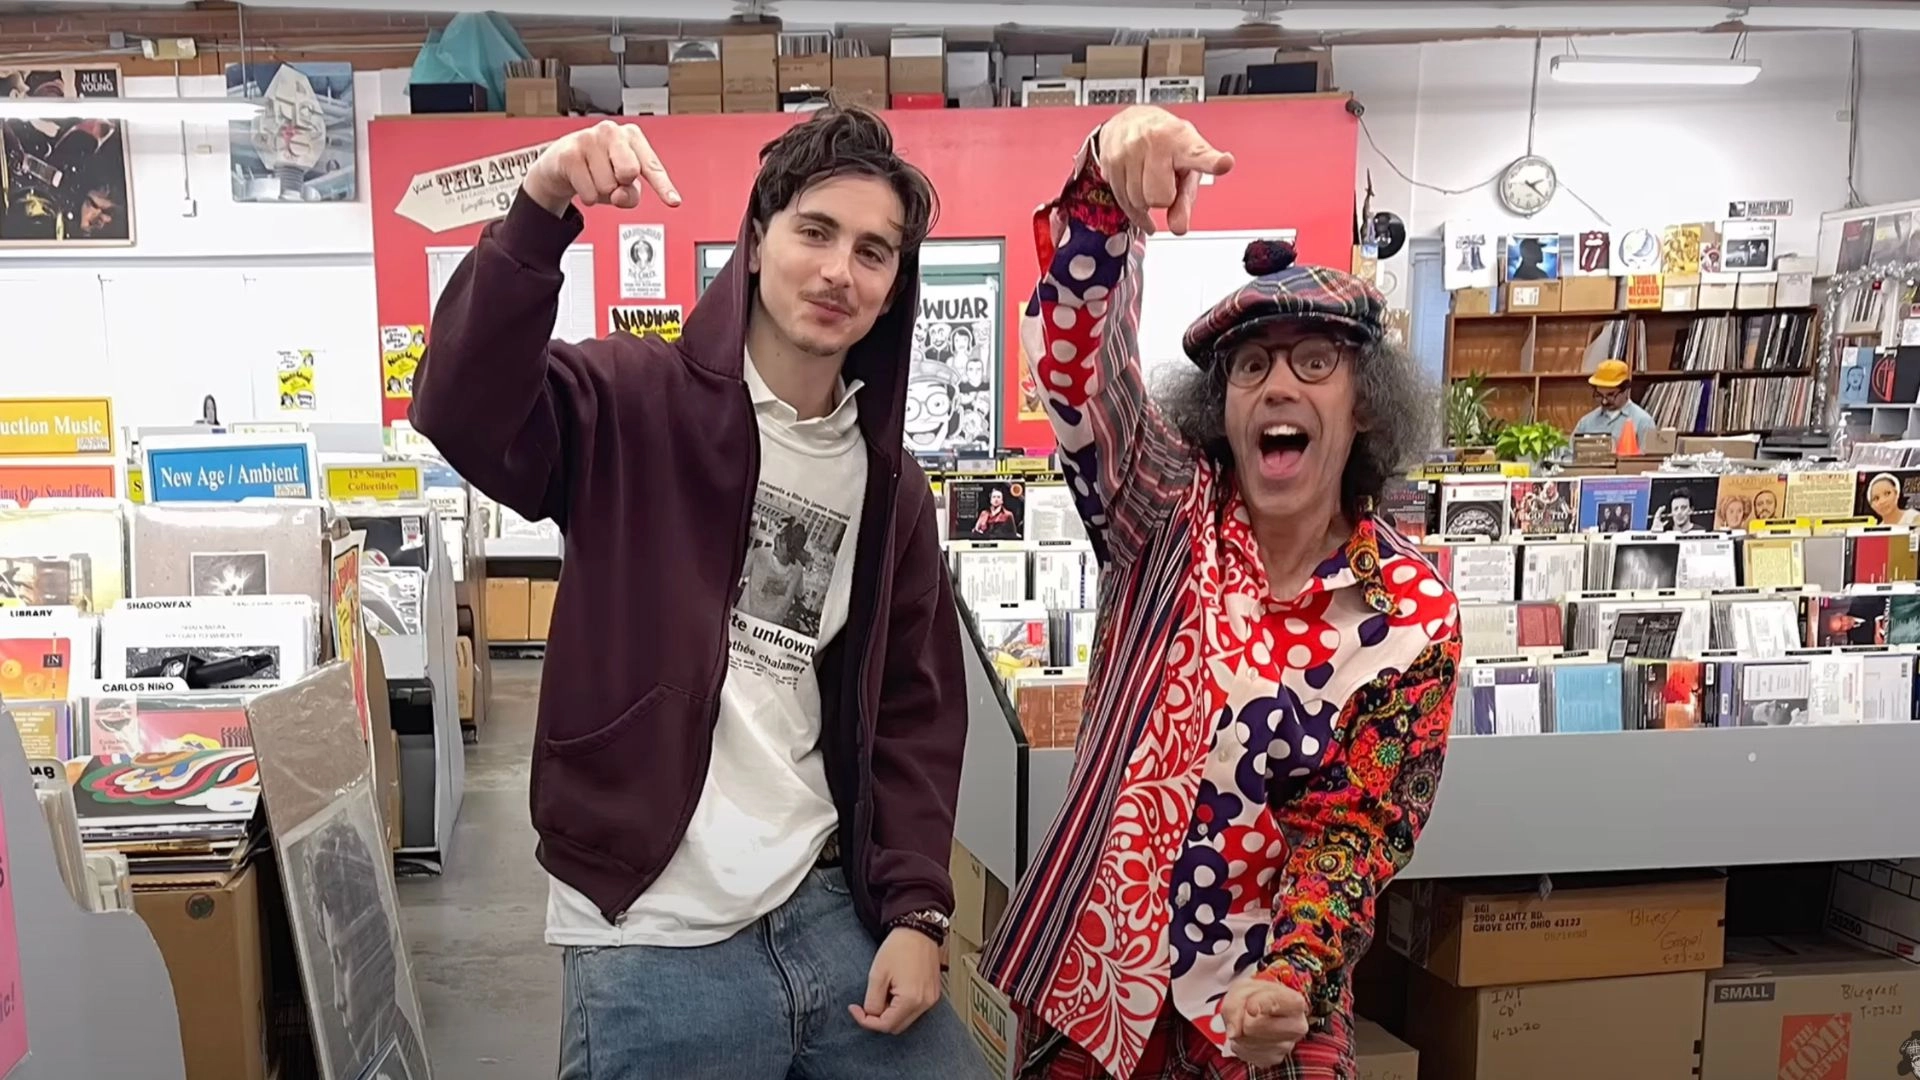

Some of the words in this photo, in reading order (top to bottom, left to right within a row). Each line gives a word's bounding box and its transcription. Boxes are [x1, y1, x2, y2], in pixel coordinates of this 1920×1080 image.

[82, 72, 109, 82] NEIL
[81, 81, 114, 92] YOUNG
[436, 164, 485, 196] THE
[487, 147, 549, 184] ATT
[612, 307, 681, 331] NARDWUAR
[54, 415, 102, 434] Music
[367, 469, 397, 480] Singles
[1426, 465, 1443, 474] NEW
[1444, 465, 1460, 473] AGE
[1465, 465, 1482, 473] NEW
[1484, 464, 1498, 473] AGE
[160, 467, 193, 488] New
[197, 466, 225, 492] Age
[238, 462, 300, 485] Ambient
[348, 482, 399, 492] Collectibles
[126, 600, 192, 611] SHADOWFAX
[10, 609, 53, 618] LIBRARY
[752, 626, 816, 658] unkown
[758, 653, 806, 675] chalamet
[102, 682, 145, 693] CARLOS
[1473, 922, 1502, 932] GROVE
[1505, 921, 1528, 931] CITY,
[1530, 919, 1551, 929] OHIO
[1719, 985, 1770, 1000] SMALL
[1789, 1021, 1818, 1051] THE
[1778, 1014, 1850, 1080] HOME
